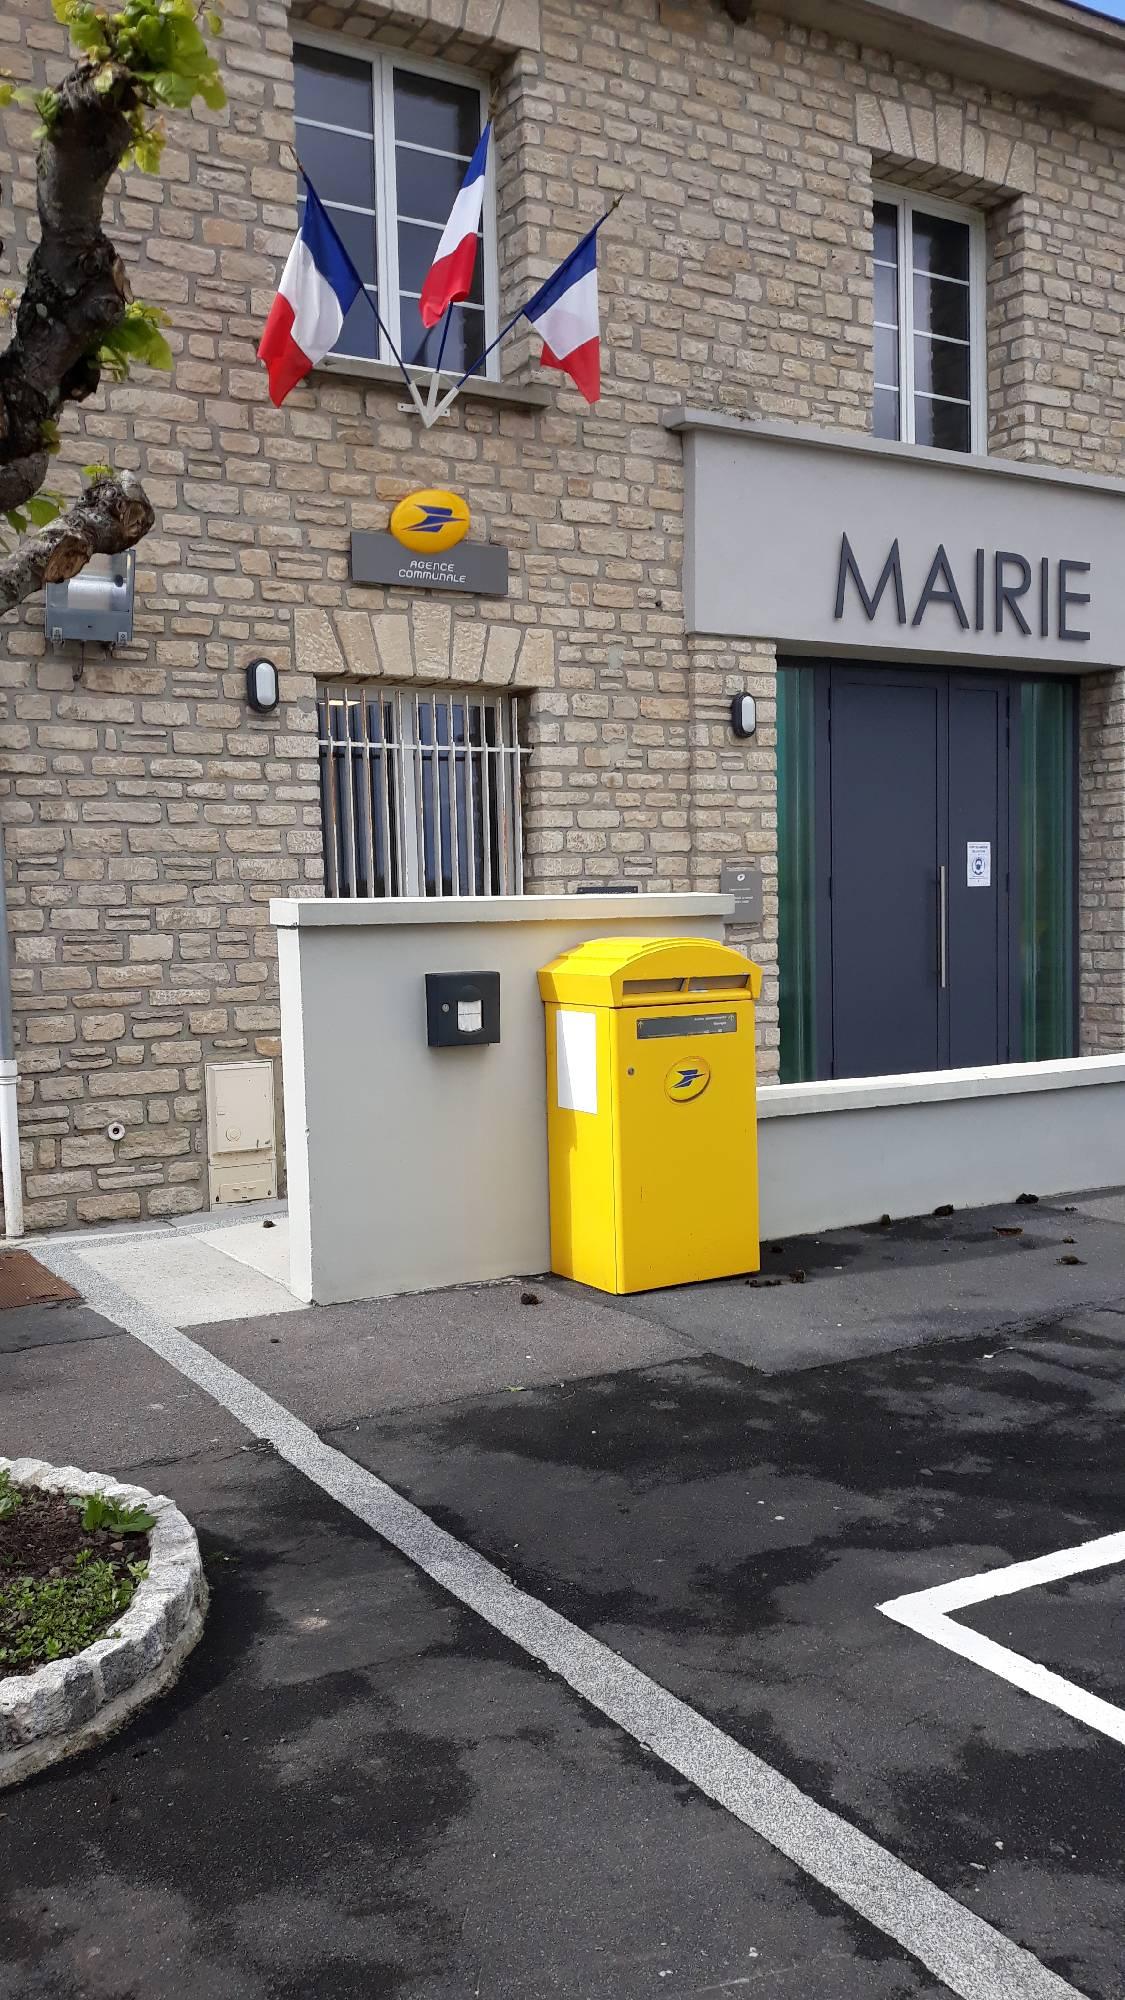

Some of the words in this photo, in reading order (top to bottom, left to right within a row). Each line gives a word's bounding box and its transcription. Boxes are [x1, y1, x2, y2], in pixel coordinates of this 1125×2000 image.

[410, 560, 454, 573] AGENCE
[398, 568, 467, 583] COMMUNALE
[834, 531, 1091, 641] MAIRIE
